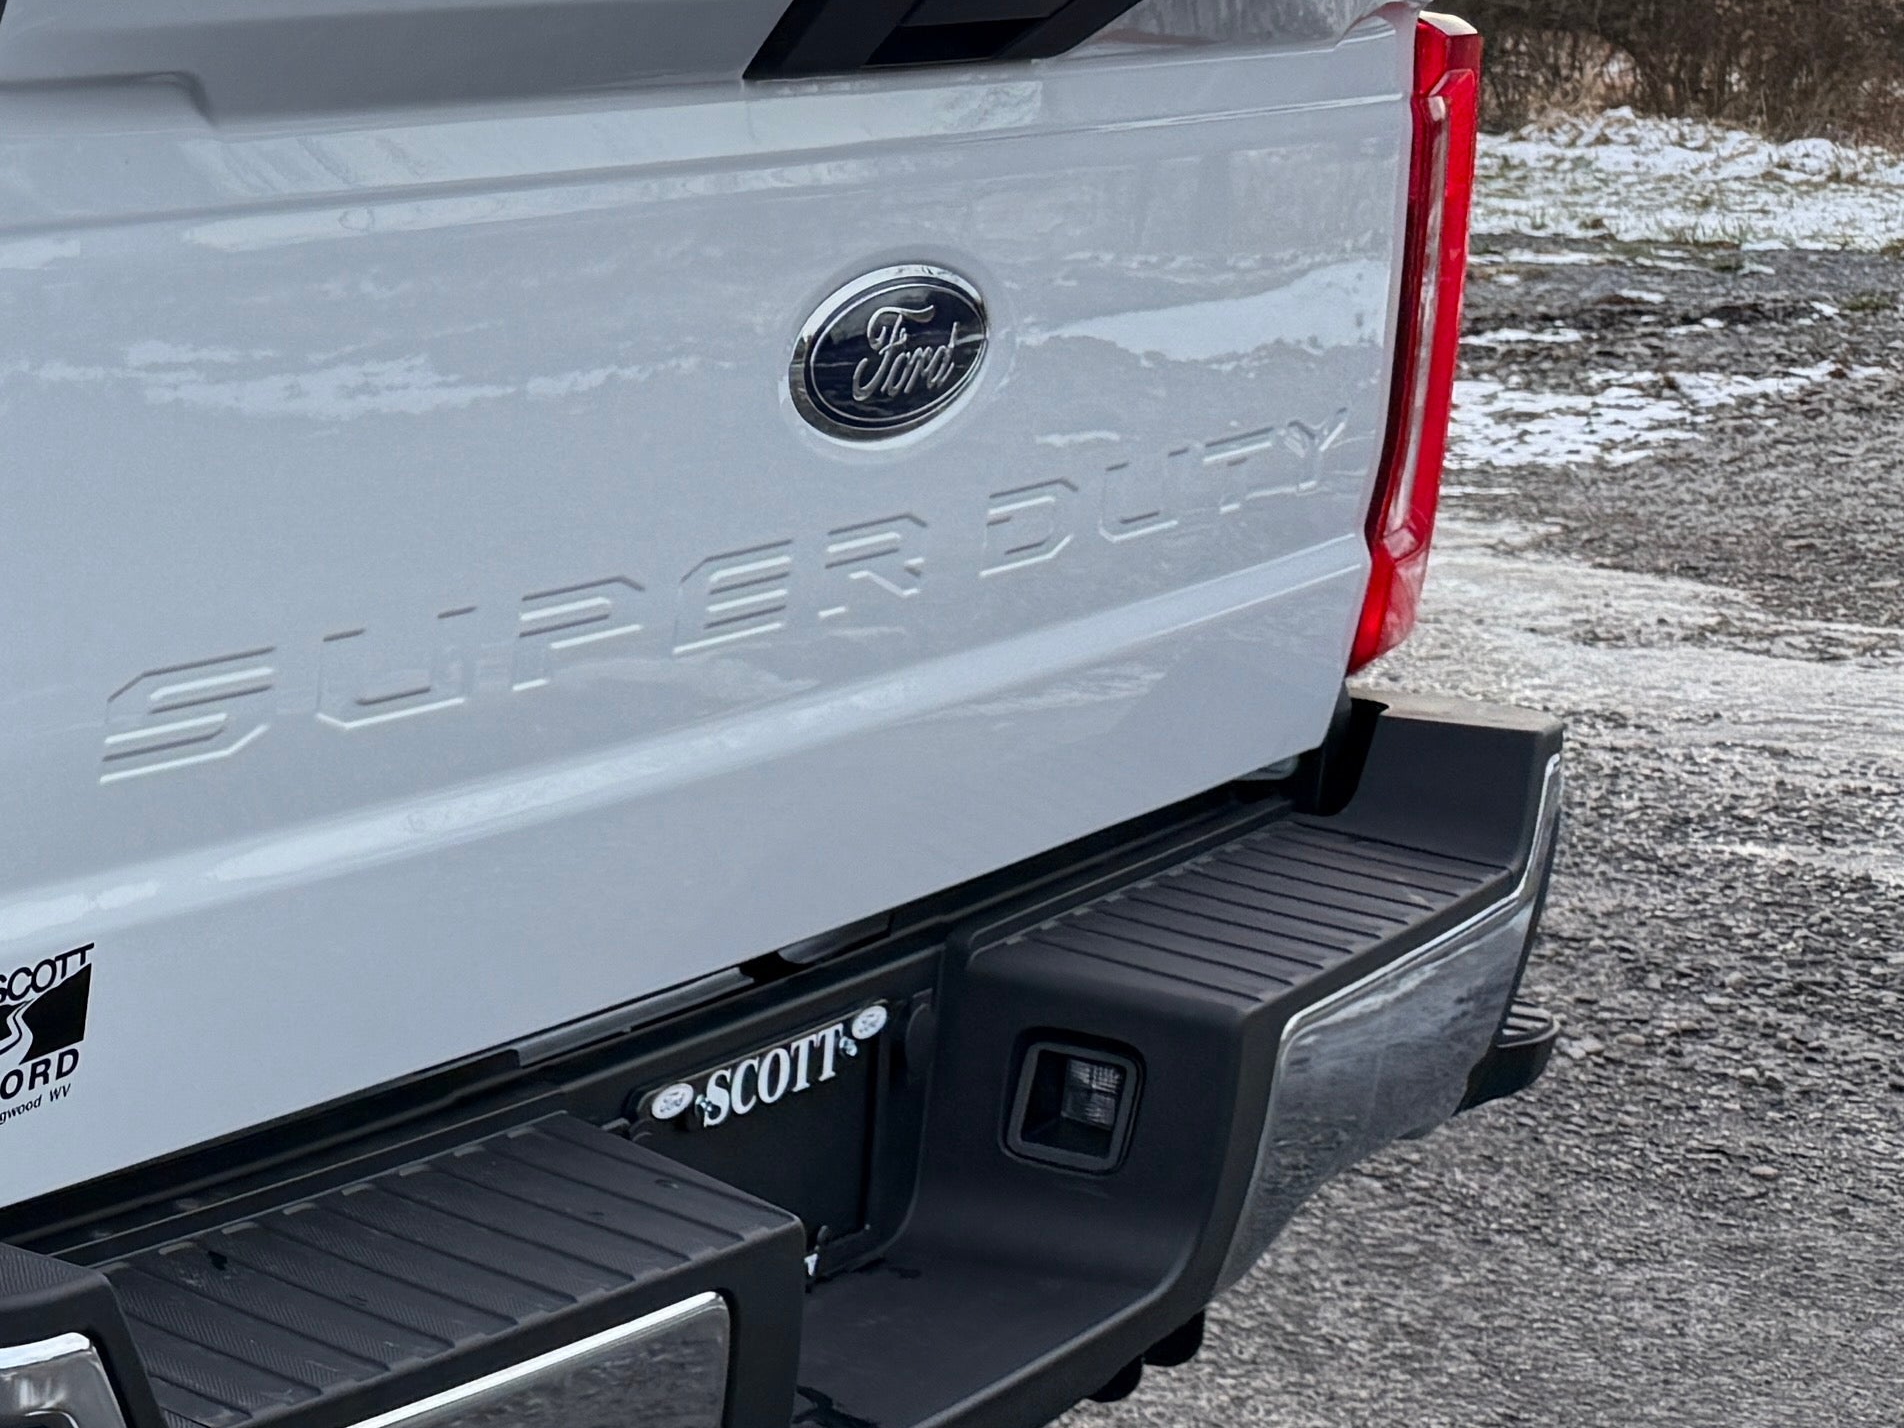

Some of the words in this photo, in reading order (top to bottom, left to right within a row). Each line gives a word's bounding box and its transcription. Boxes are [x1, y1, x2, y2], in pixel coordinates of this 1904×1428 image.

[853, 303, 959, 402] Ford
[100, 509, 927, 784] SUPER
[980, 406, 1349, 579] DUTY
[49, 1083, 71, 1103] WV
[701, 1022, 843, 1129] SCOTT
